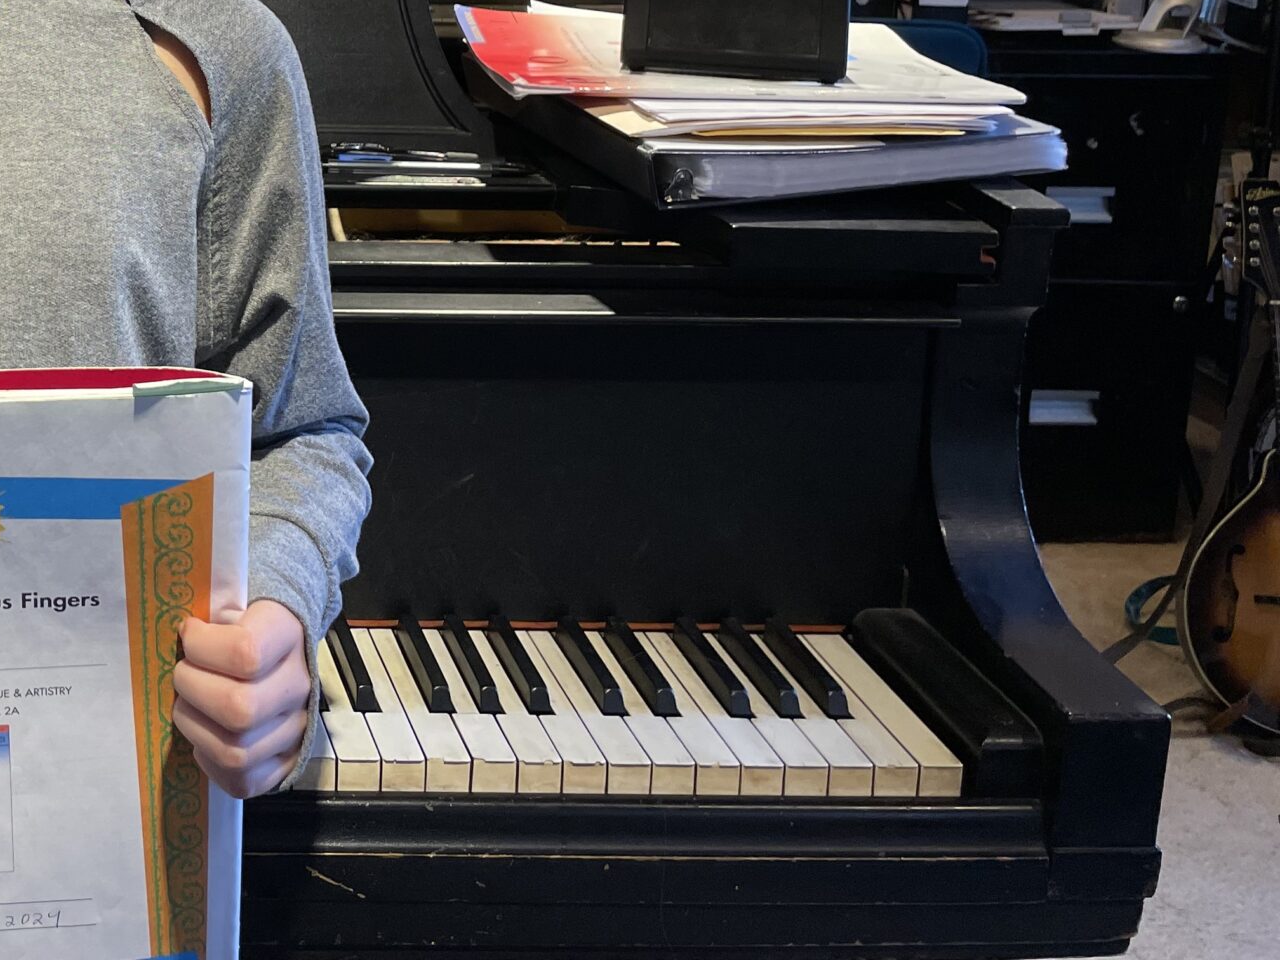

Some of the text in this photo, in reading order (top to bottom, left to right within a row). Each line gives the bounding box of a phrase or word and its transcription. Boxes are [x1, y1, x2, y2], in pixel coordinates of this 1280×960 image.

[21, 591, 100, 613] Fingers
[13, 688, 22, 698] &
[25, 686, 72, 697] ARTISTRY
[4, 706, 20, 716] 2A
[5, 909, 61, 929] 2024
